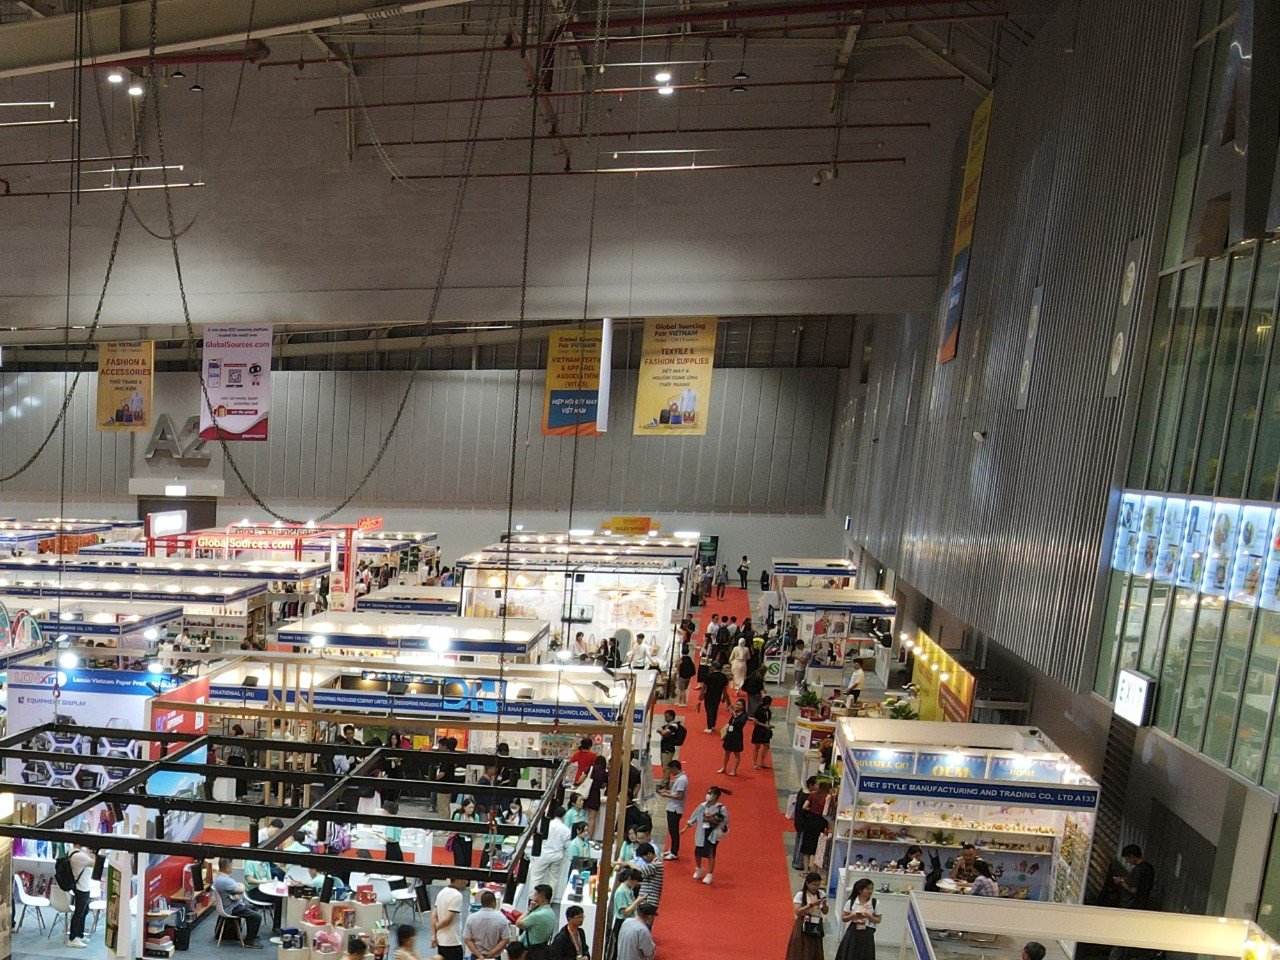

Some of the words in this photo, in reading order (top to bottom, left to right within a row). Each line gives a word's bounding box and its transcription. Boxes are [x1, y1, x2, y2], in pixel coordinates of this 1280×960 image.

[206, 341, 270, 349] GlobalSources.com
[106, 358, 140, 366] FASHION
[676, 357, 709, 365] SUPPLIES
[100, 368, 152, 376] ACCESSORIES
[62, 699, 86, 707] DISPLAY
[863, 780, 880, 789] VIET
[882, 782, 907, 791] STYLE
[909, 784, 978, 795] MANUFACTURING
[979, 789, 998, 797] AND
[1000, 790, 1036, 799] TRADING
[1075, 794, 1095, 803] A133
